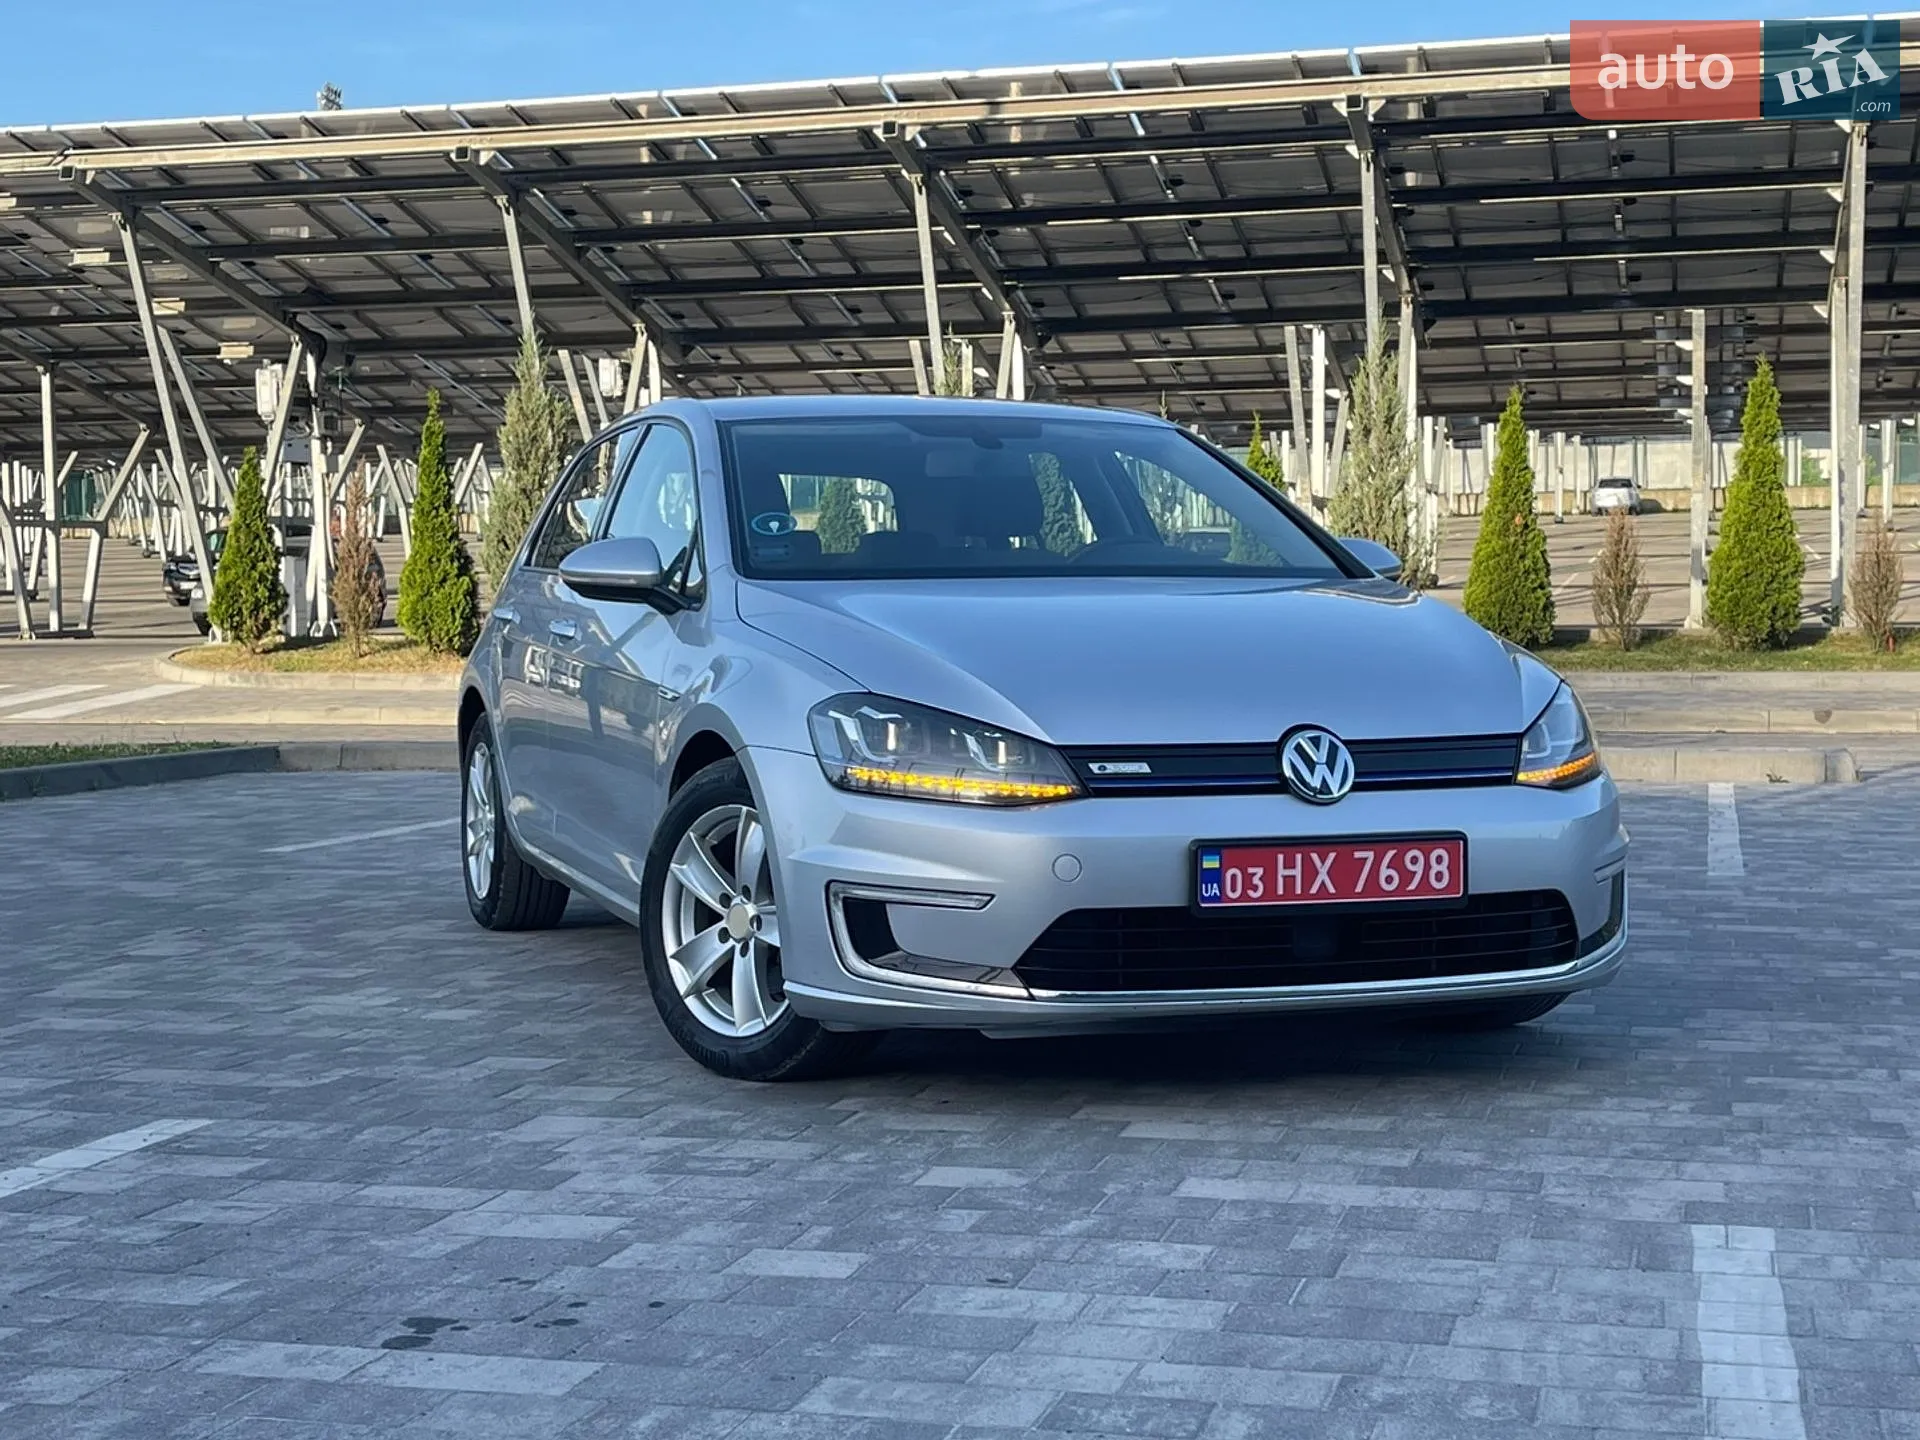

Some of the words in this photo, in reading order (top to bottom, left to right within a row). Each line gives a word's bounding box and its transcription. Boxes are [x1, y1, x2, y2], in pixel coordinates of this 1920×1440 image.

[1283, 731, 1353, 798] VW
[1202, 883, 1220, 897] UA
[1224, 867, 1264, 899] 03
[1276, 852, 1337, 895] HX
[1353, 848, 1450, 893] 7698
